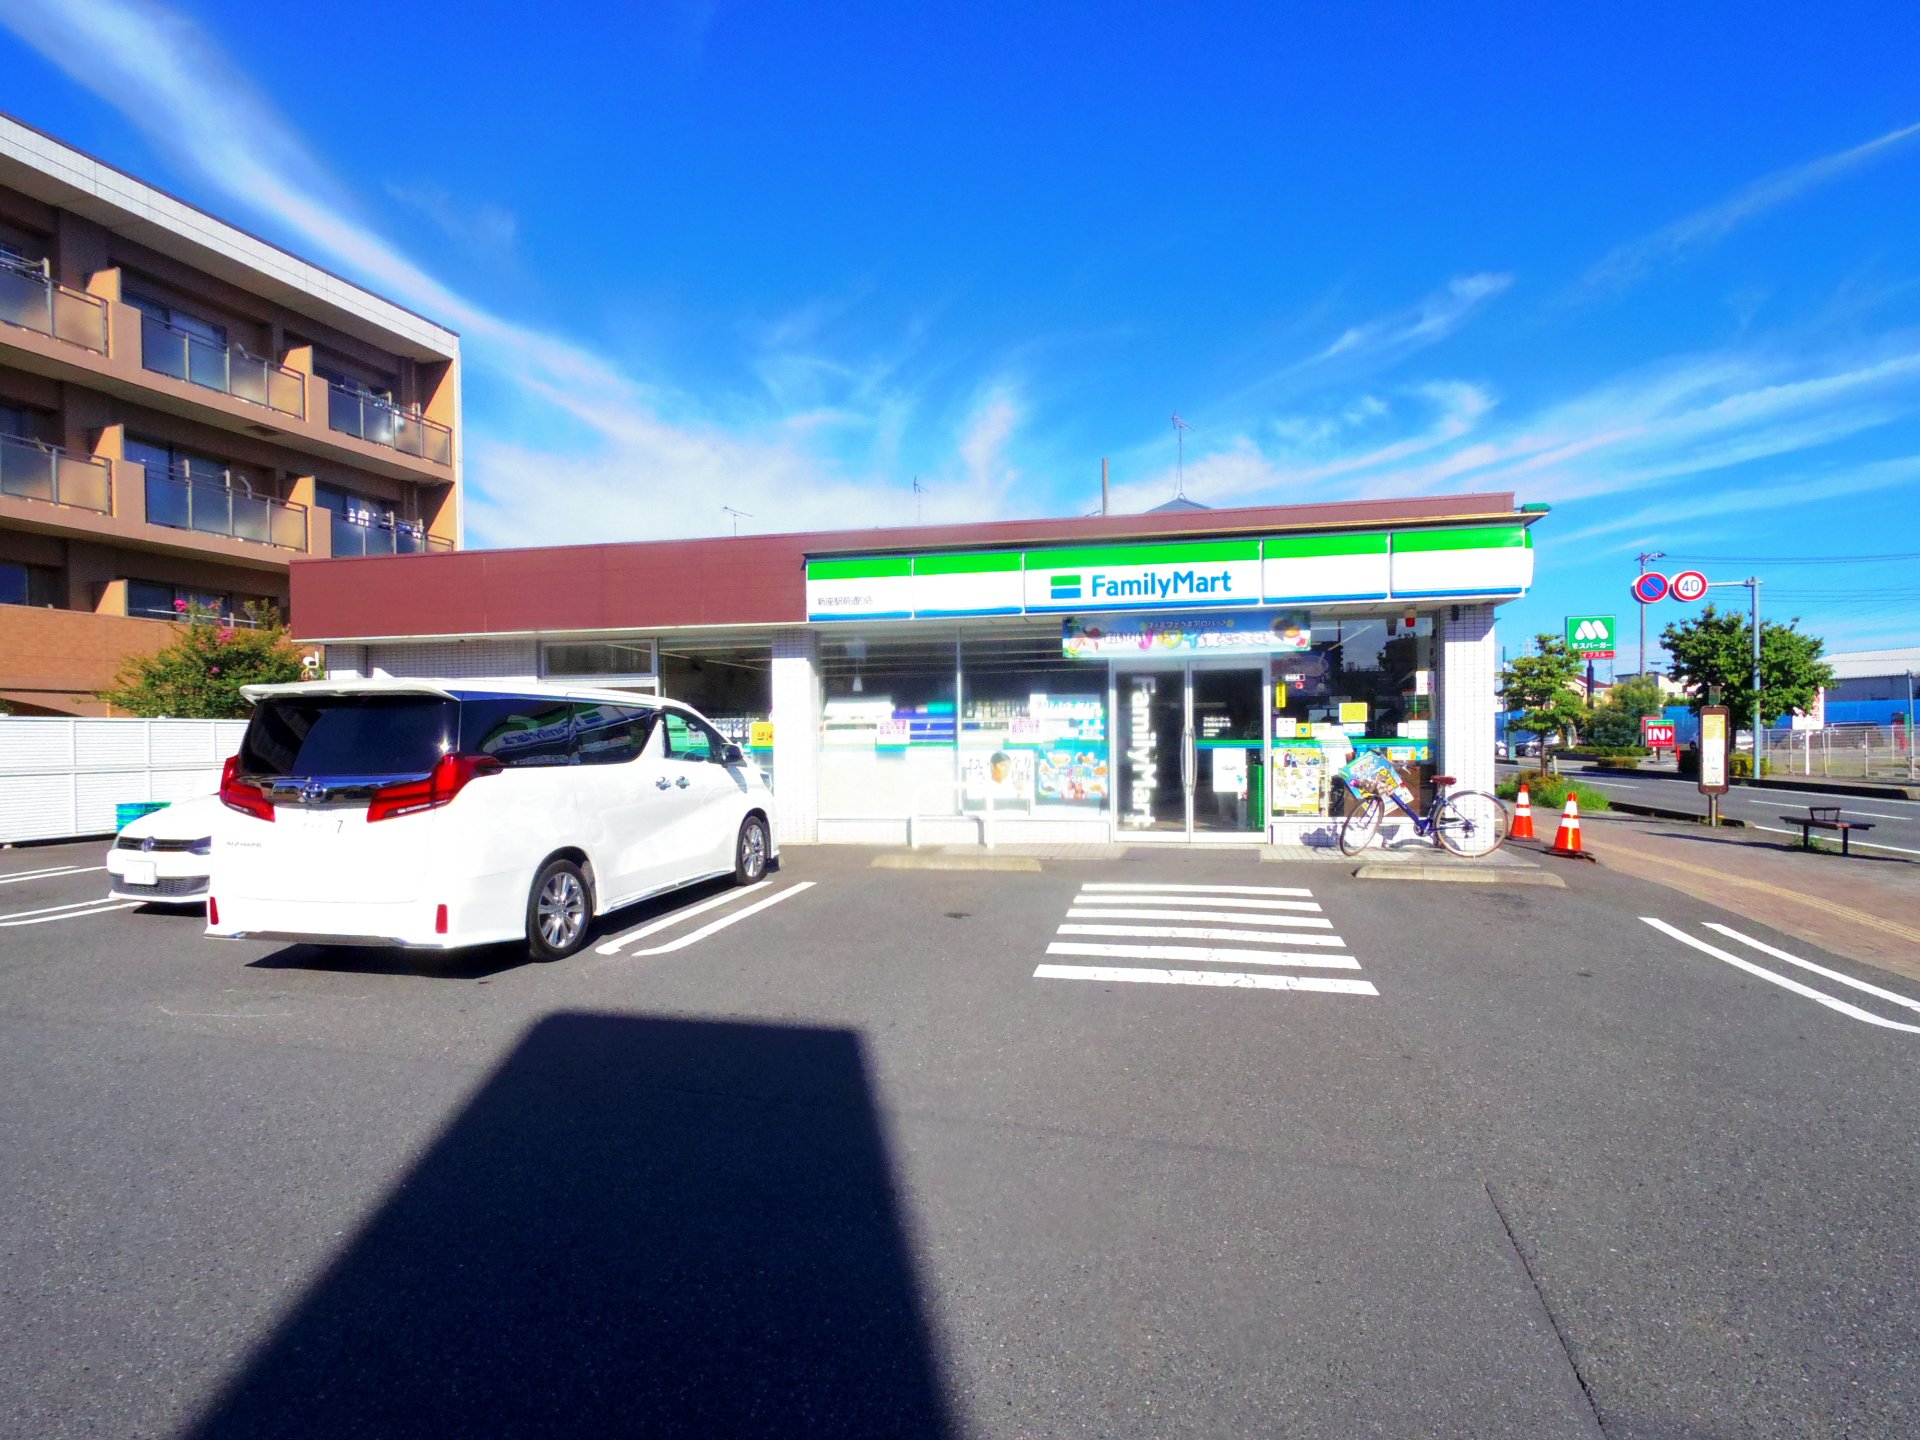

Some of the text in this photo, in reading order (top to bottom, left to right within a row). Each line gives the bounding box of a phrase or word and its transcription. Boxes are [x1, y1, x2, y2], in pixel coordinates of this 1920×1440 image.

[1091, 570, 1232, 599] FamilyMart
[1681, 579, 1700, 592] 40
[1647, 728, 1666, 741] IN
[1126, 676, 1157, 828] FamilyMart
